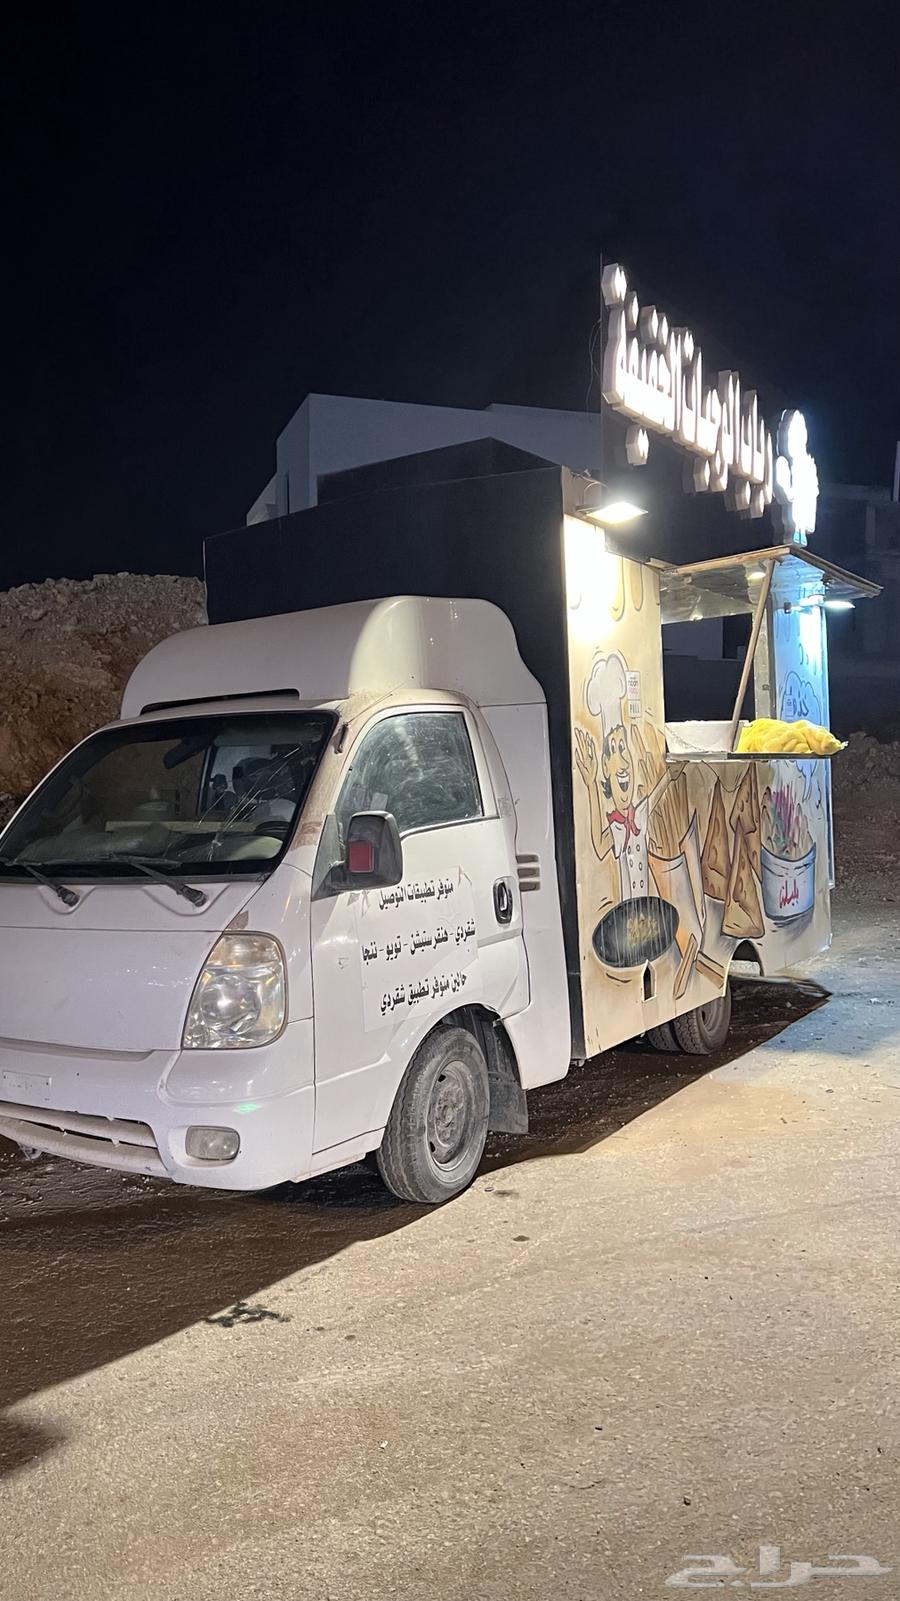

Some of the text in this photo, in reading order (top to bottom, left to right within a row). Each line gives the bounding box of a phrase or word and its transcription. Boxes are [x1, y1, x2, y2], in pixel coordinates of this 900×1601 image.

[600, 262, 683, 466] الخفيفة
[379, 878, 454, 910] متوفر تطبيقات التوصيل
[454, 918, 476, 946] شقردي
[386, 935, 402, 961] تويو
[380, 984, 406, 1015] شقردي
[408, 978, 429, 1005] تطبيق
[432, 974, 450, 999] متوفر
